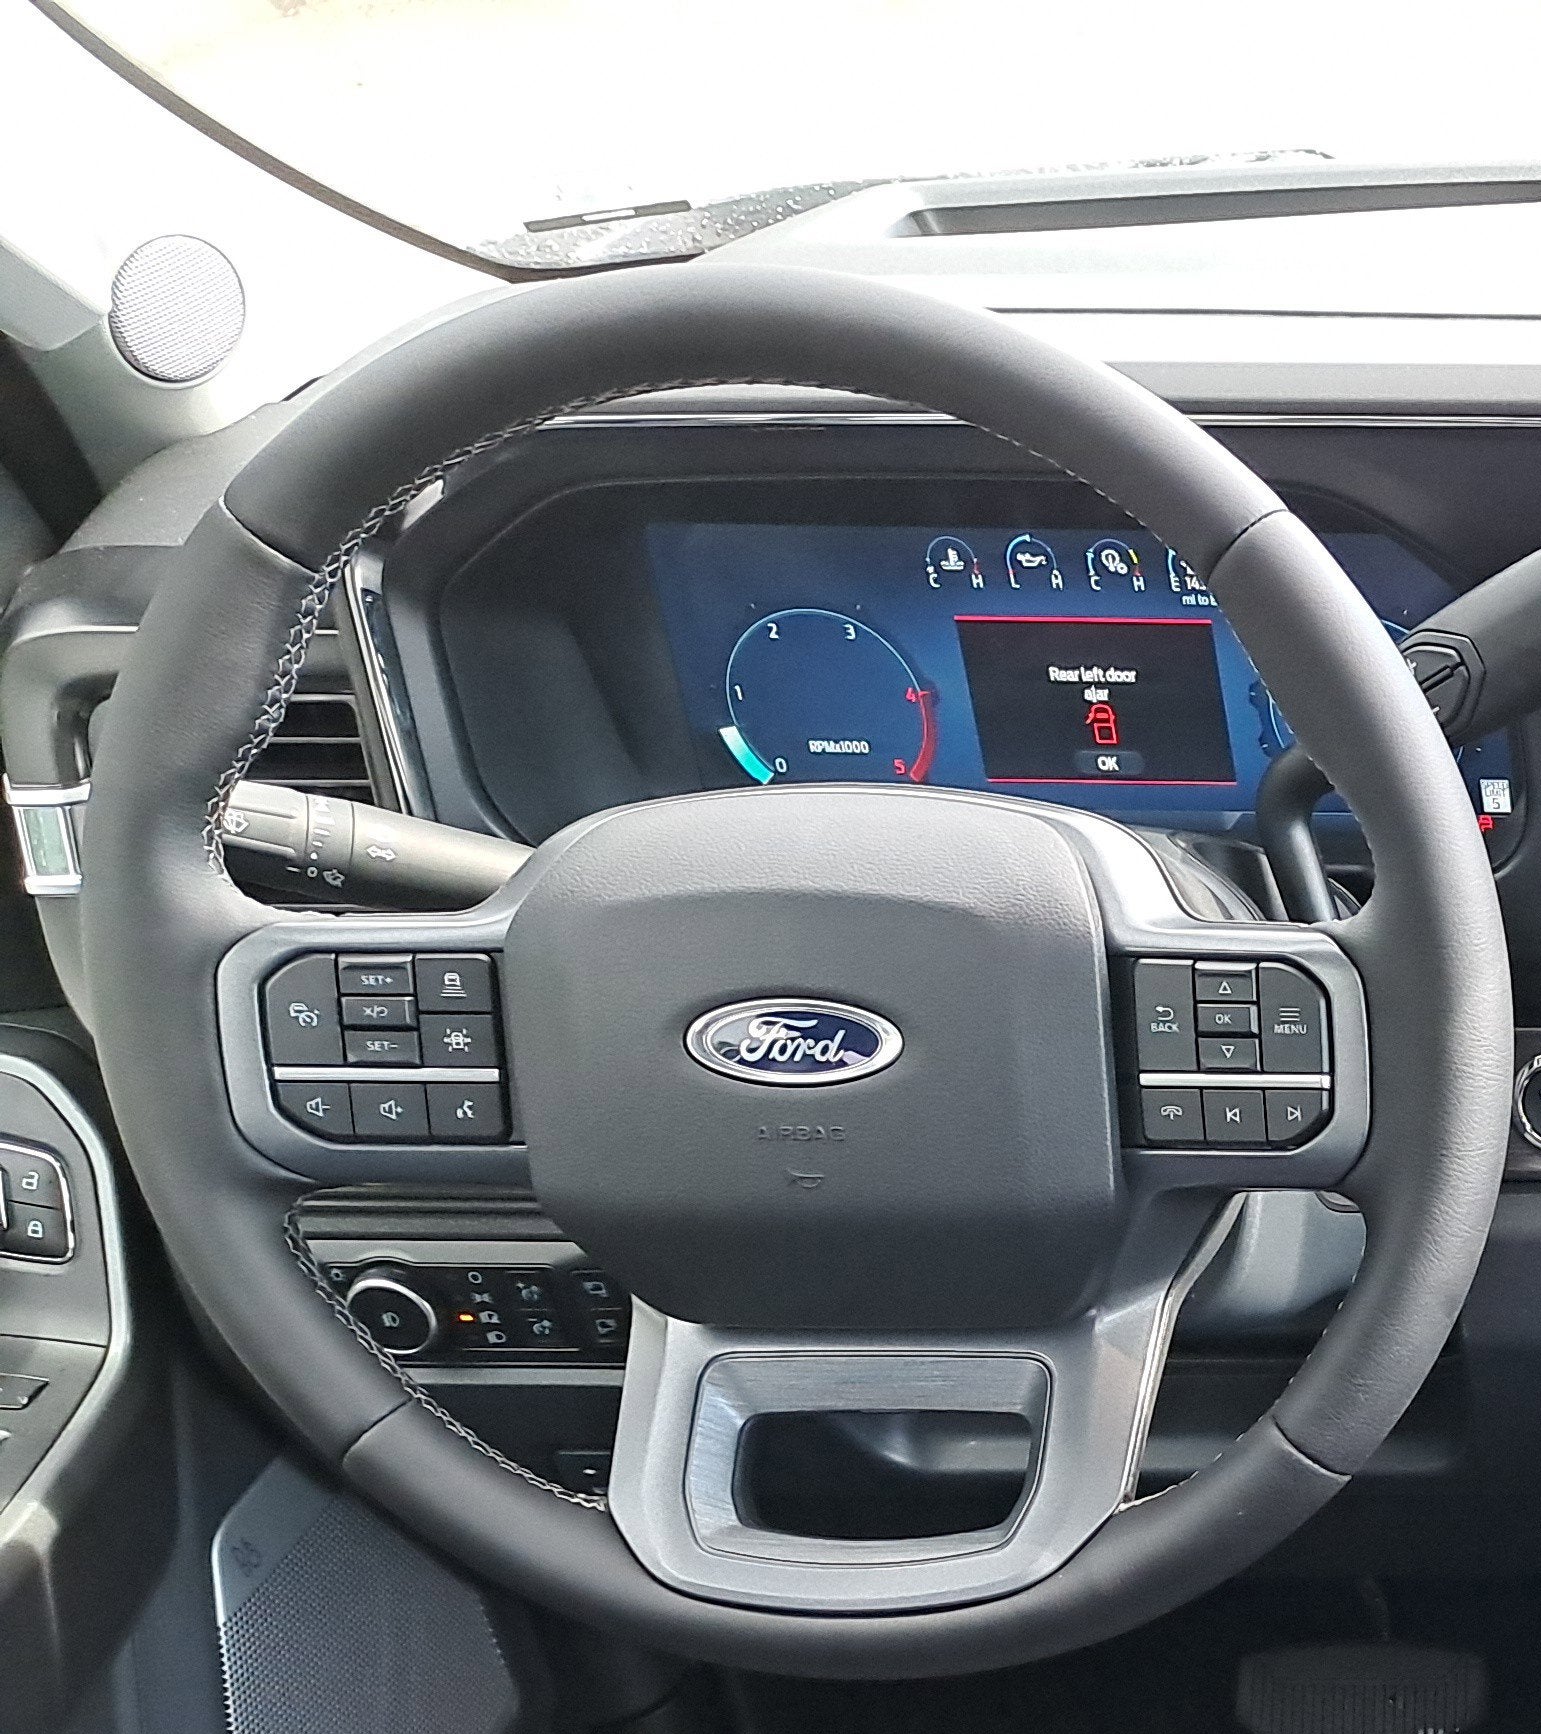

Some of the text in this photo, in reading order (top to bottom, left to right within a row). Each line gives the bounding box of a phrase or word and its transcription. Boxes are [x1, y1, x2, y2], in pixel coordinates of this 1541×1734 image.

[929, 573, 941, 588] C
[971, 573, 985, 589] H
[1010, 573, 1021, 588] L
[1132, 575, 1145, 591] H
[766, 622, 780, 640] 2
[842, 623, 857, 641] 3
[1048, 665, 1137, 683] Rear left door
[733, 684, 744, 702] 1
[905, 686, 917, 703] 4
[1084, 684, 1109, 703] ajar
[774, 757, 788, 774] 0
[893, 758, 906, 775] 5
[1097, 756, 1120, 771] OK
[1150, 1020, 1180, 1034] BACK
[1215, 1012, 1232, 1025] OK
[1273, 1022, 1308, 1036] MENU
[740, 1016, 847, 1063] Ford
[757, 1125, 845, 1142] ARBAG
